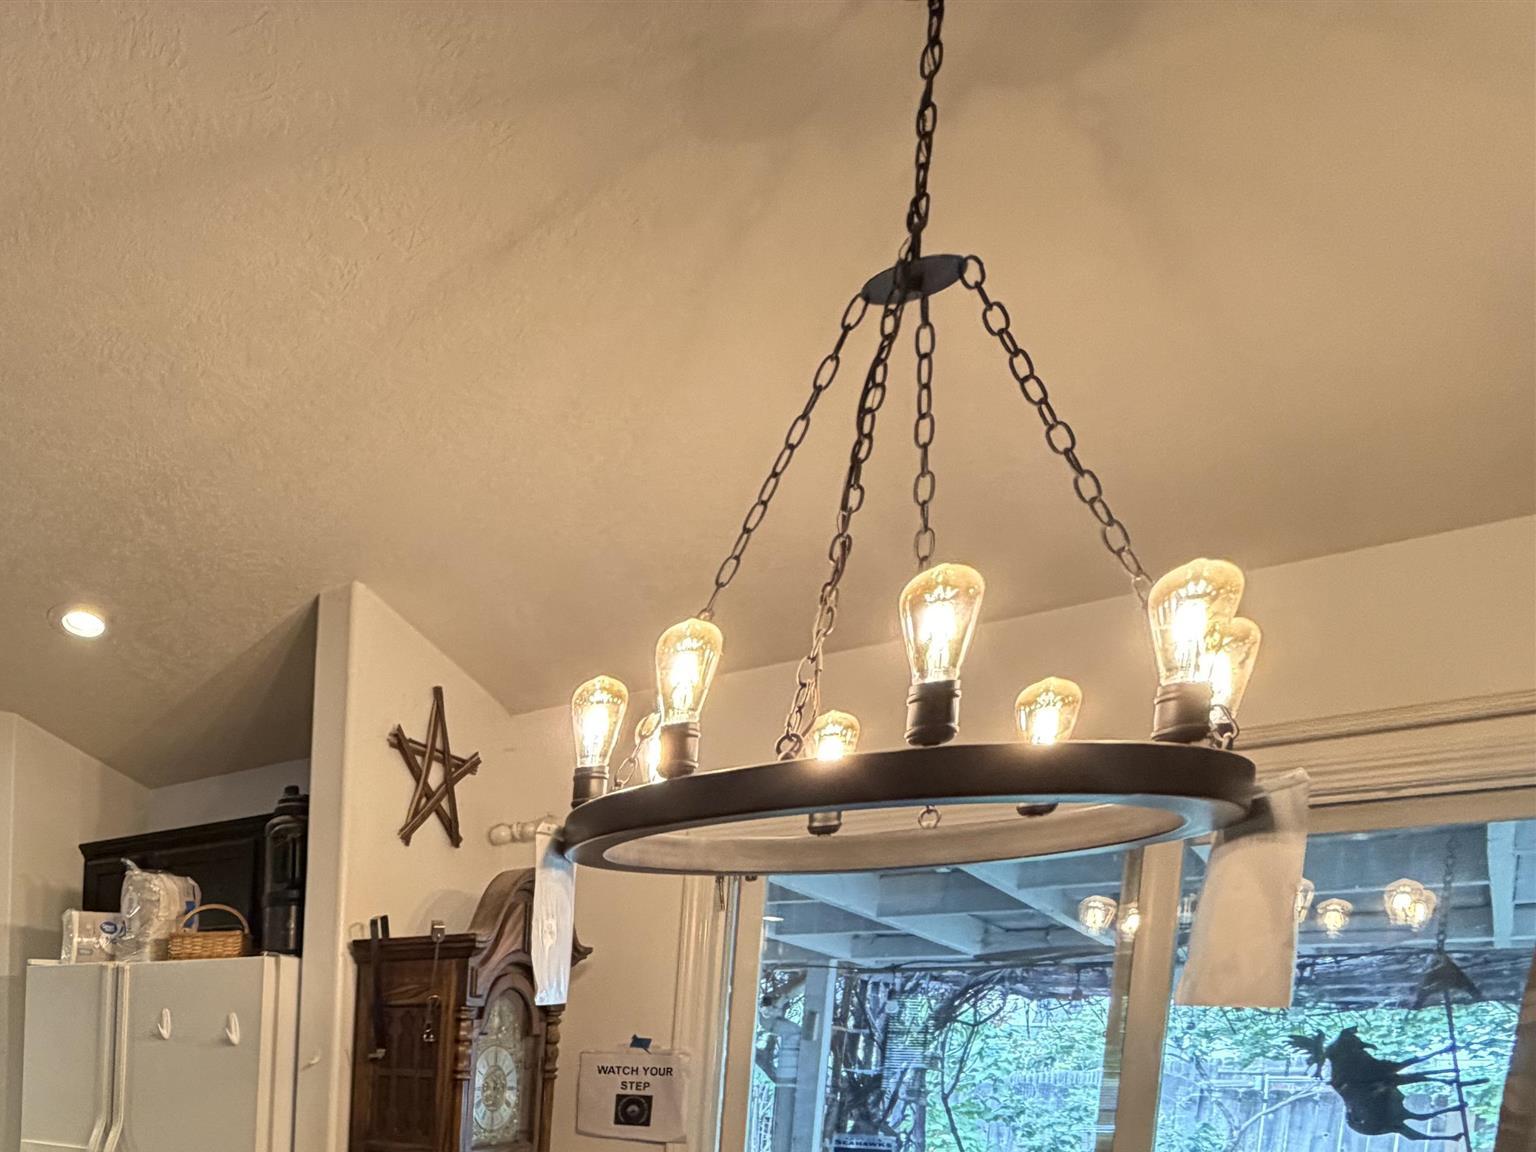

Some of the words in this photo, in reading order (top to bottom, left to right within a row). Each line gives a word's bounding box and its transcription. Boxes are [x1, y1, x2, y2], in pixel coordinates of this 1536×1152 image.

[597, 1065, 639, 1076] WATCH
[642, 1066, 674, 1077] YOUR
[620, 1081, 651, 1091] STEP
